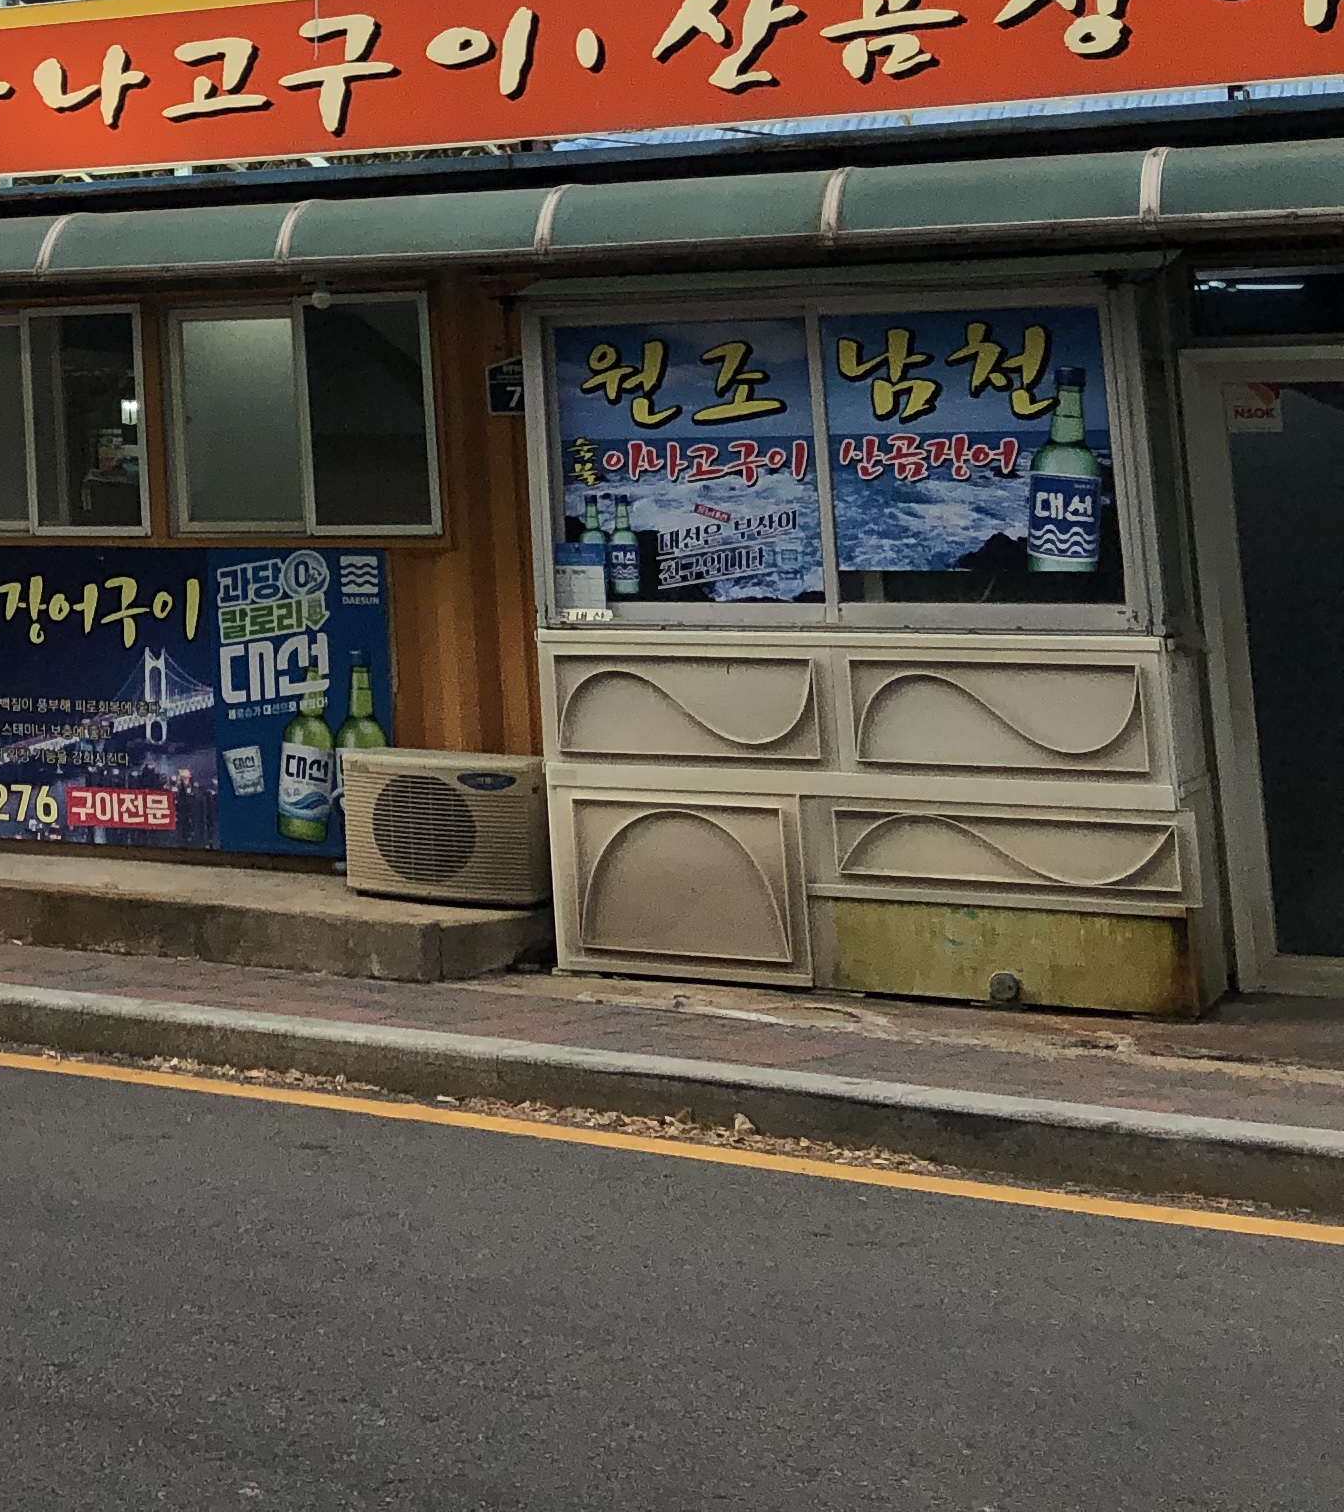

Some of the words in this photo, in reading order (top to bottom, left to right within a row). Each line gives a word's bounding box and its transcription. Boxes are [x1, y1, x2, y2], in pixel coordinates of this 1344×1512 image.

[581, 340, 785, 425] 원조
[837, 322, 1057, 422] 남천
[1233, 407, 1276, 419] NSOK
[840, 433, 1019, 481] 산곰장어
[1034, 491, 1095, 523] 대선
[657, 522, 723, 554] 대선은
[218, 559, 283, 606] 과당
[659, 546, 766, 584] 친구입니다
[341, 596, 380, 605] DAESUN
[219, 599, 305, 643] 칼로리
[220, 633, 330, 704] 대선
[37, 698, 72, 714] 풍부해
[75, 699, 132, 715] 피로회복에
[285, 754, 329, 784] 대선
[71, 790, 171, 825] 구이전문
